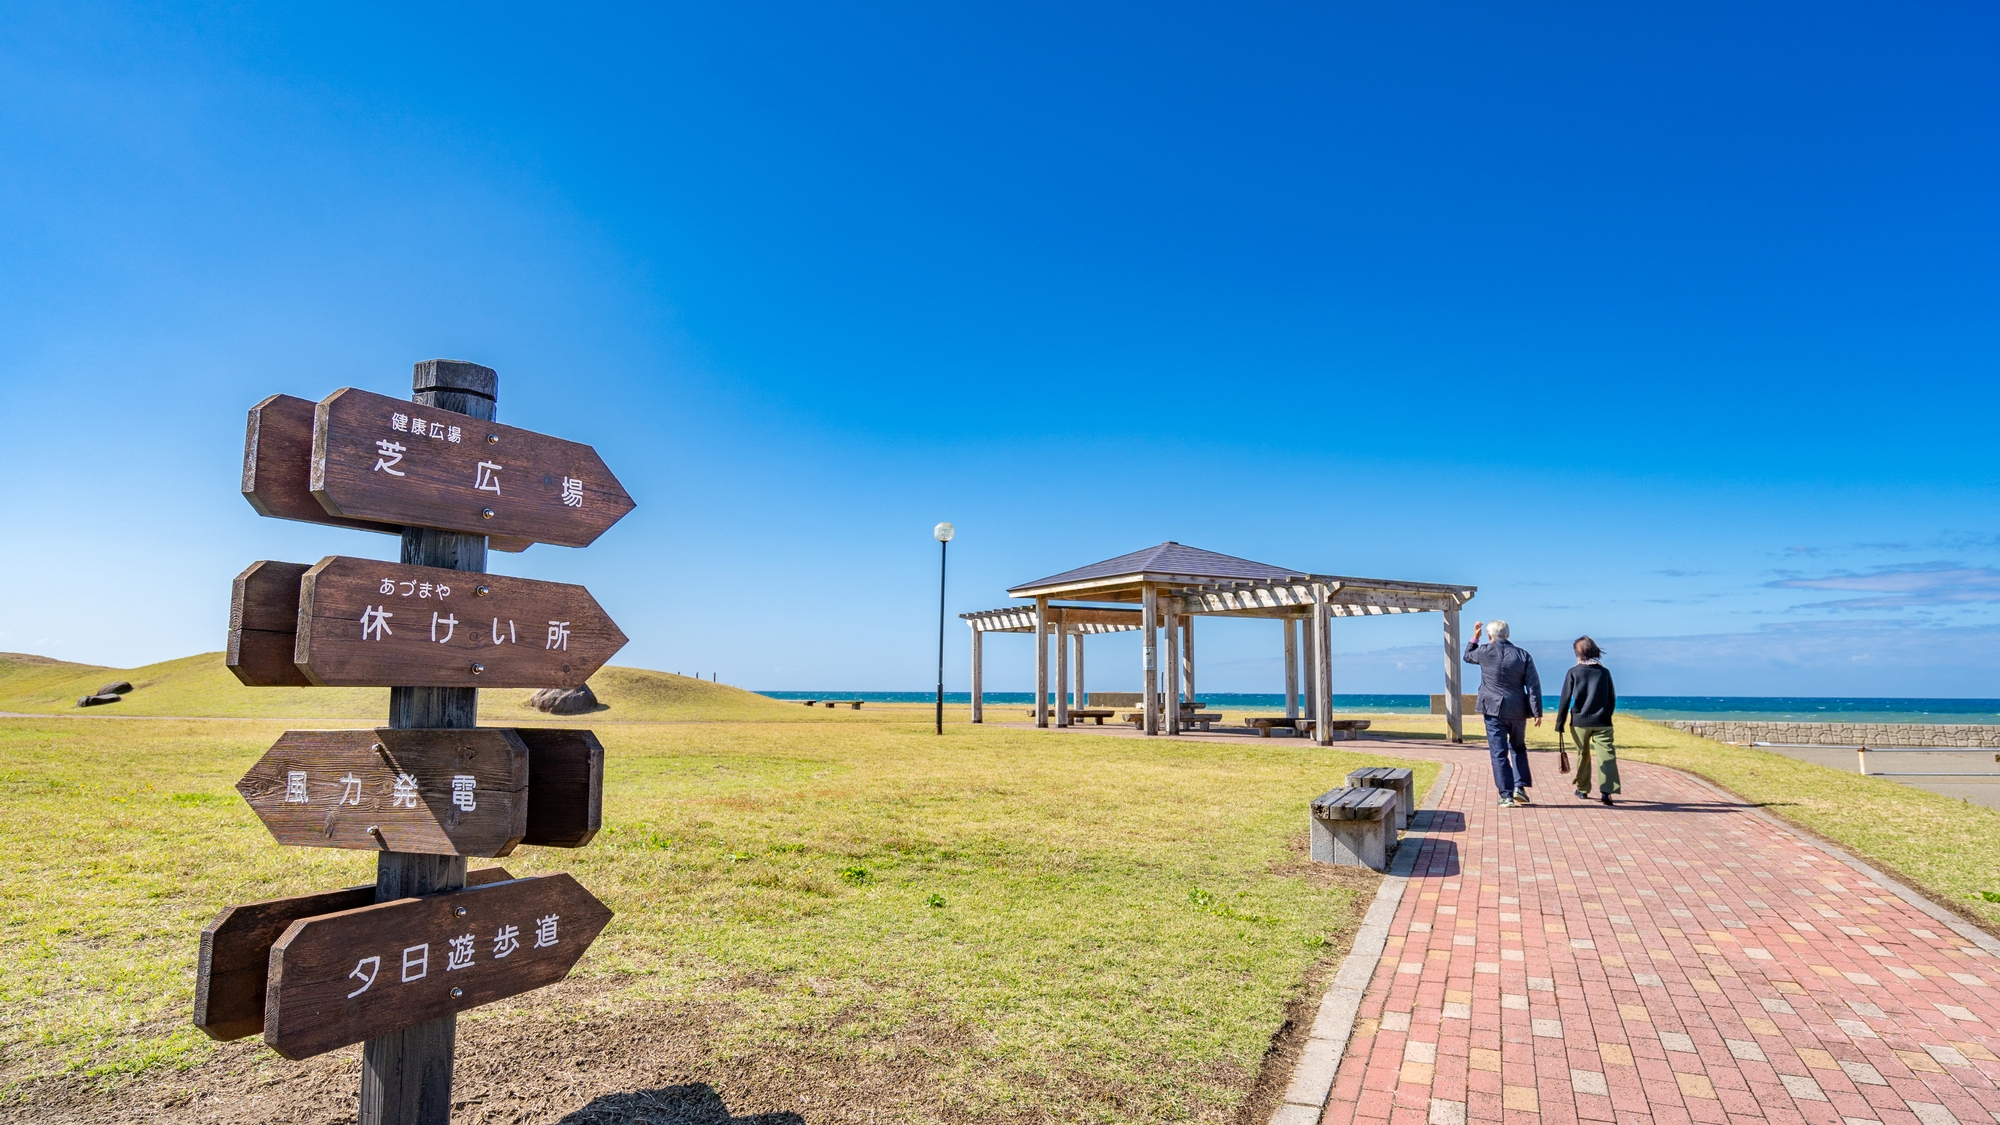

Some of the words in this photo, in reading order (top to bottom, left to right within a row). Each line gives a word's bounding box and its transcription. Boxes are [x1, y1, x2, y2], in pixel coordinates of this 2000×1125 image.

[391, 412, 462, 444] 健康広場
[374, 438, 584, 508] 芝広場
[379, 577, 451, 600] あづまや
[359, 604, 571, 652] 休けい所
[283, 770, 477, 812] 風力発電
[347, 913, 560, 999] 夕日遊歩道
